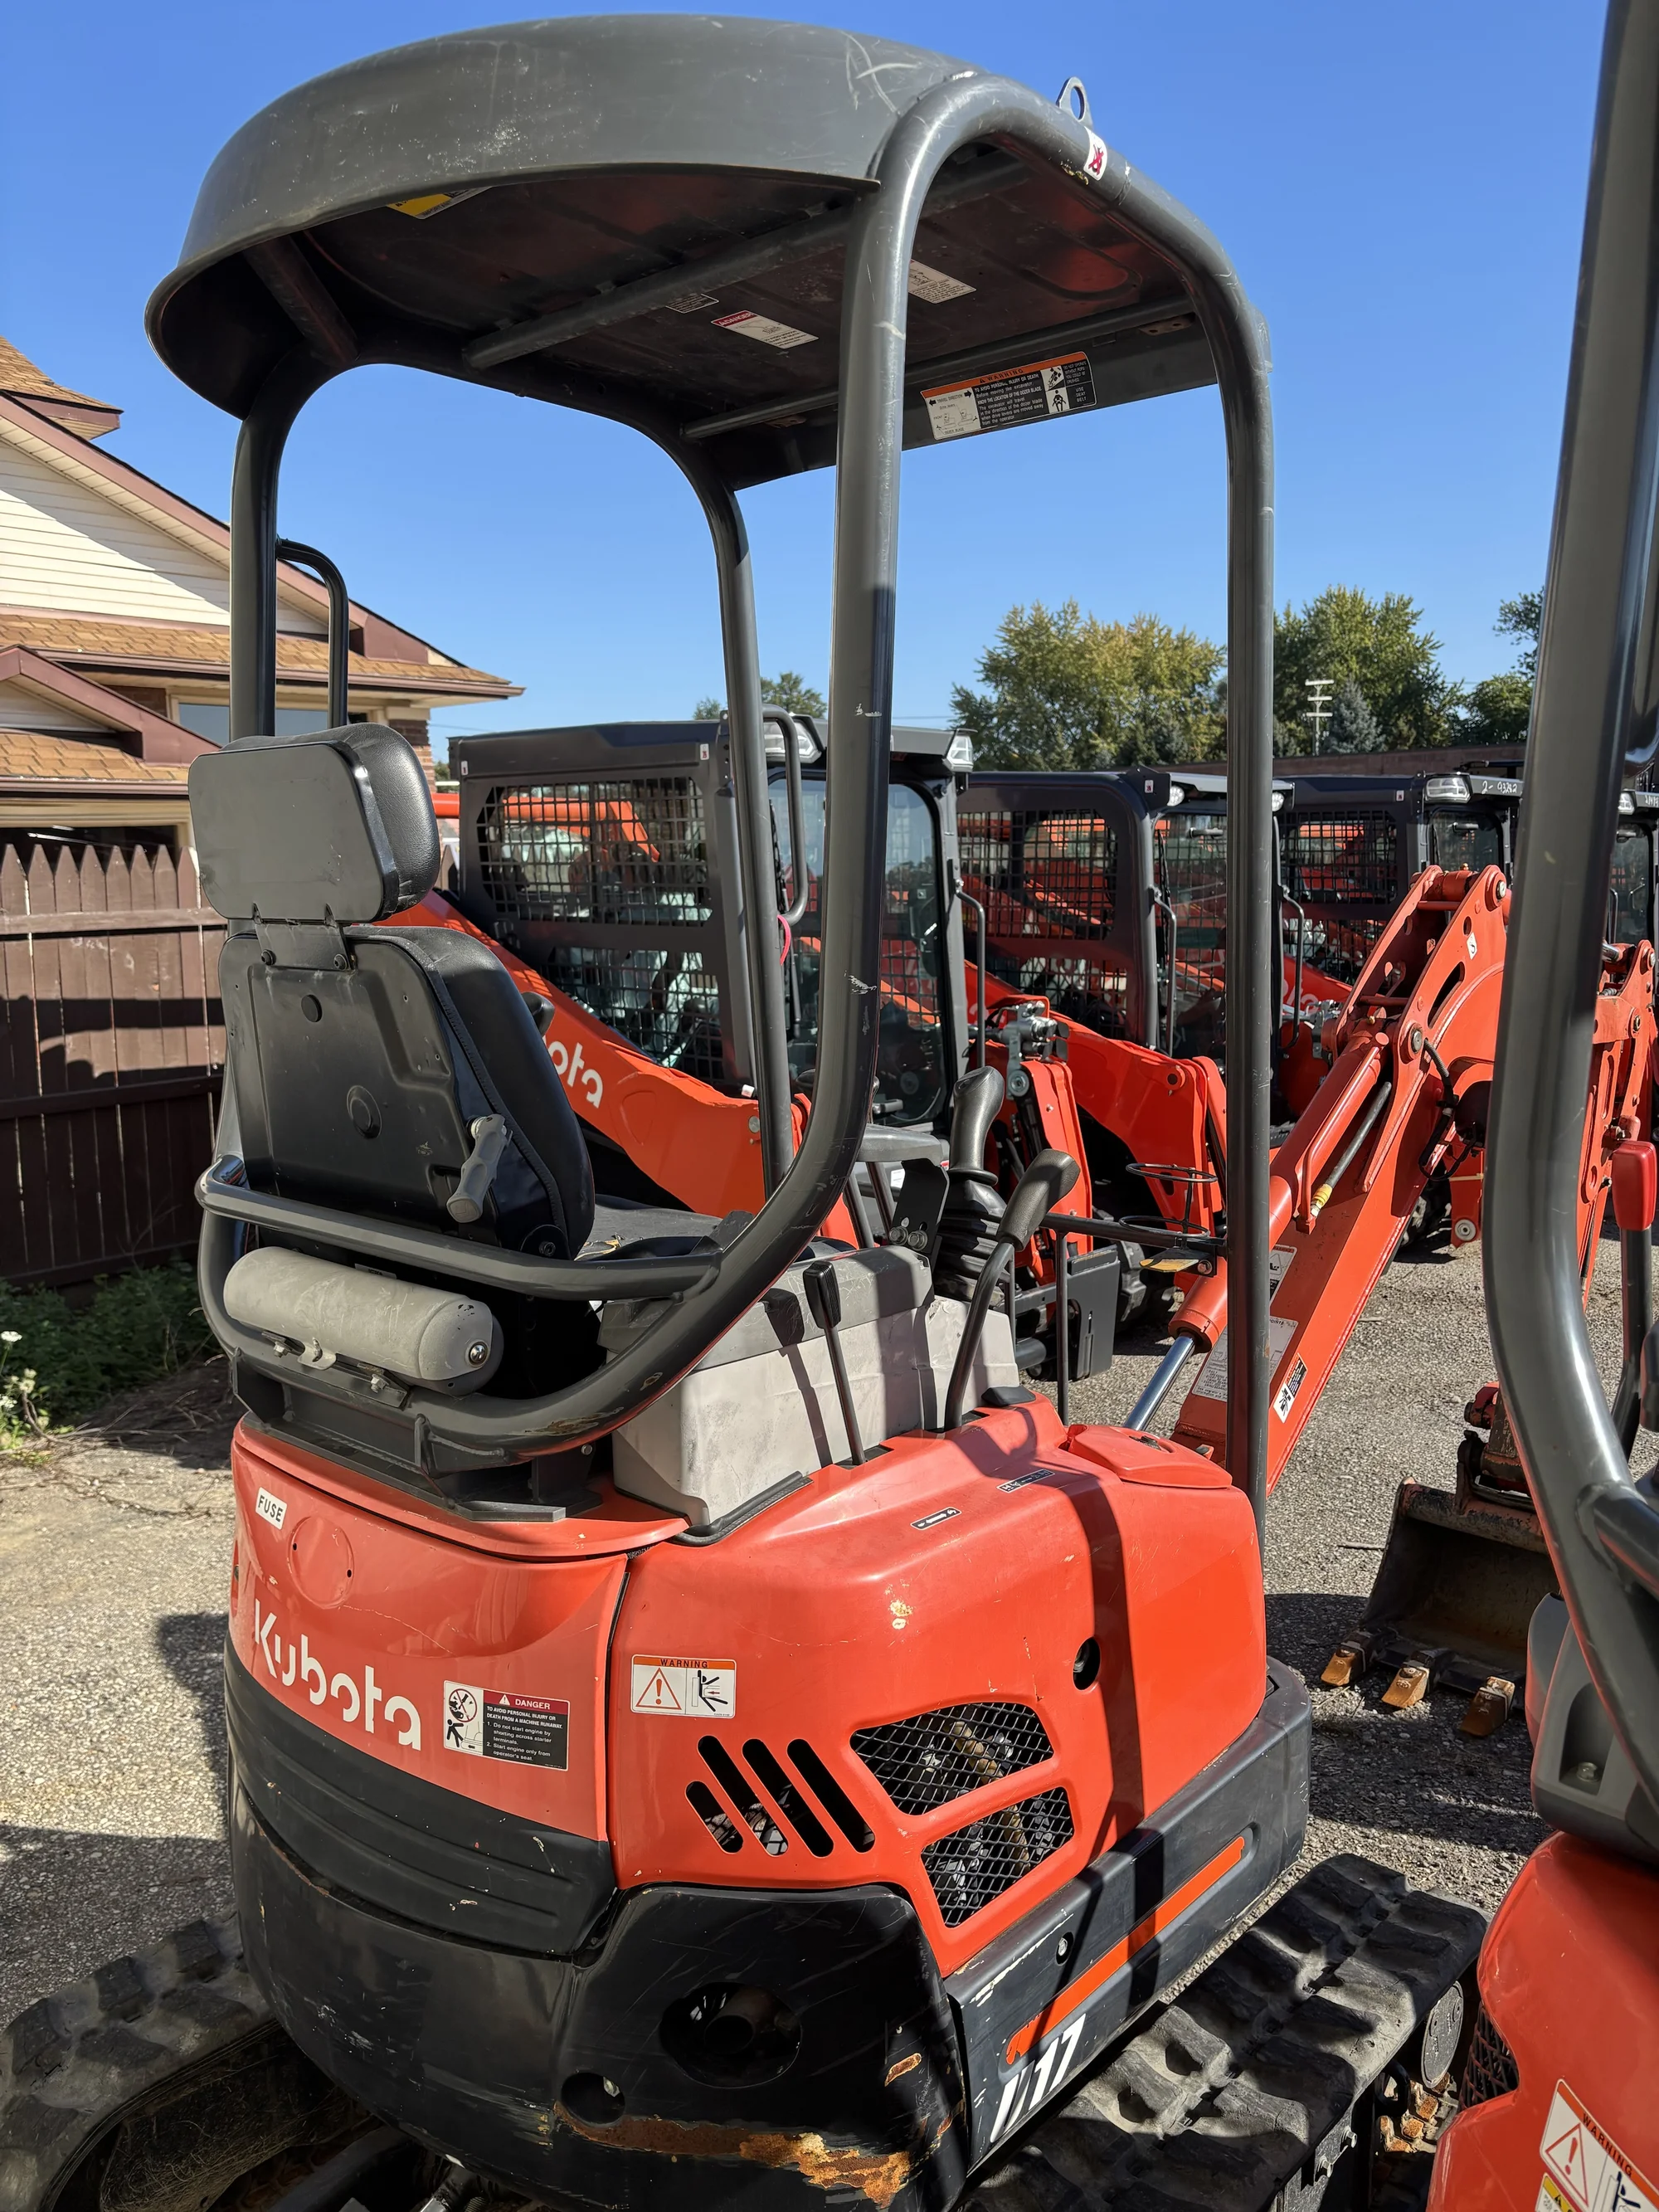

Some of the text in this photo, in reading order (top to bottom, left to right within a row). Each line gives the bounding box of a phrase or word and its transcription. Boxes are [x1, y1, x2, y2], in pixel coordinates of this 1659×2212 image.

[987, 369, 1024, 381] WARNING
[258, 1495, 284, 1523] FUSE
[660, 1659, 708, 1669] WARNING
[255, 1598, 421, 1752] Kubota
[515, 1698, 550, 1709] DANGER
[494, 1730, 514, 1738] shorting
[494, 1737, 518, 1745] terminals.
[494, 1751, 519, 1759] operator's
[1583, 2113, 1632, 2178] WARNING
